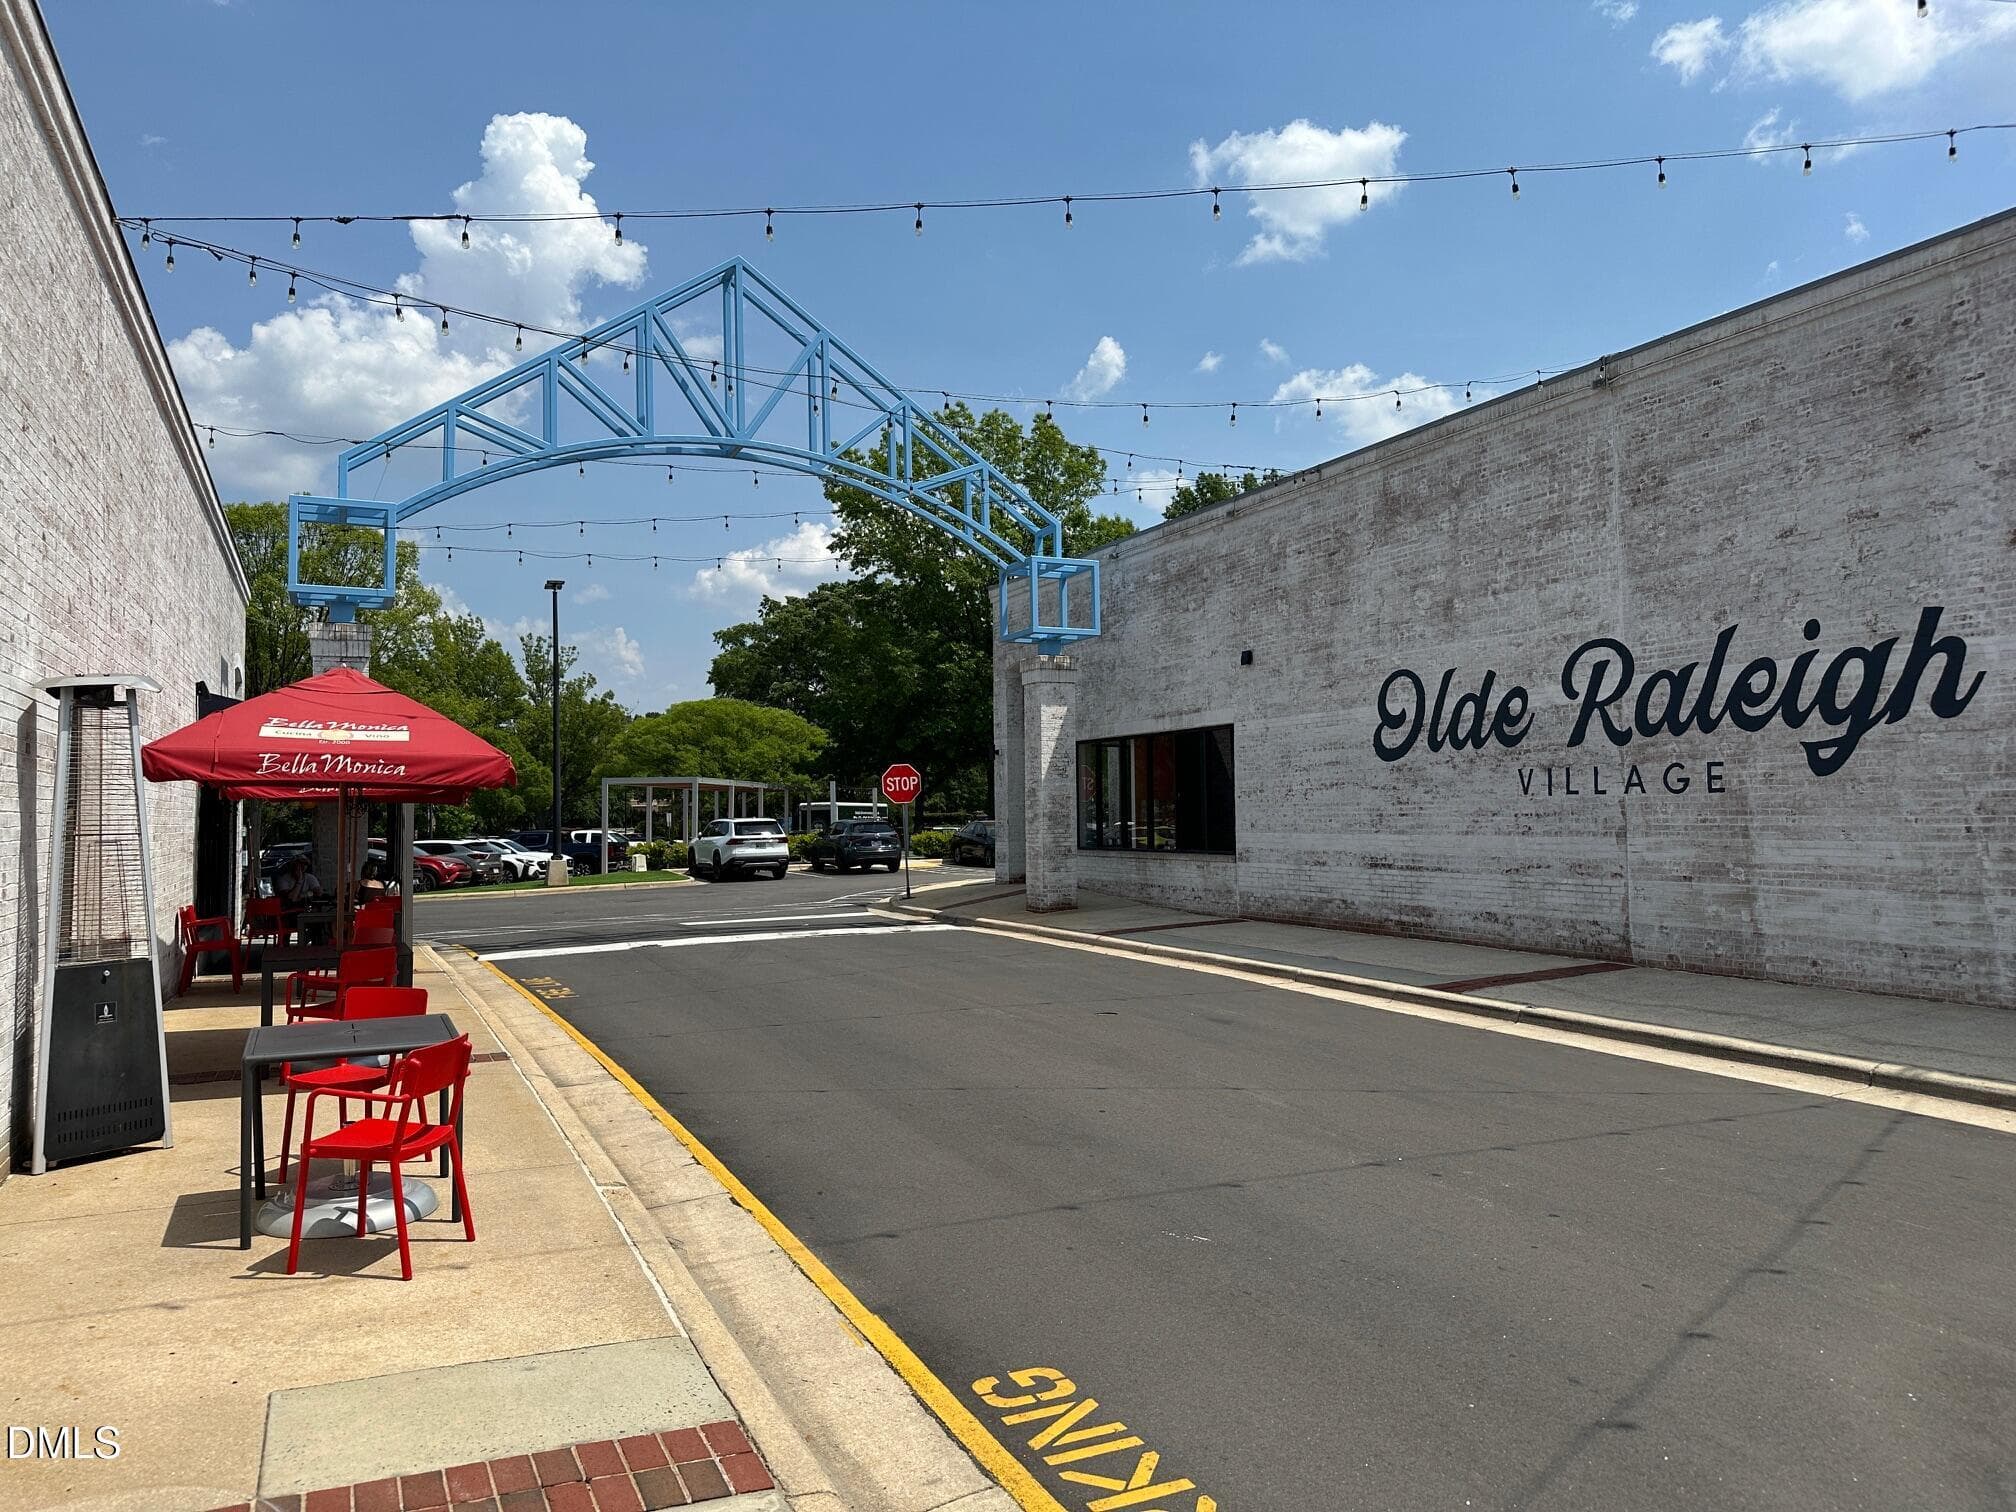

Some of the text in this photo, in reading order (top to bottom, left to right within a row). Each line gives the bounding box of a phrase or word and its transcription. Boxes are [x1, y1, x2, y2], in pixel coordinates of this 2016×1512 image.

[1373, 606, 1987, 777] Olde Raleigh
[263, 717, 409, 731] Bella Monica
[256, 753, 406, 776] Bella Monica
[1518, 761, 1726, 795] VILLAGE
[886, 776, 918, 792] STOP
[971, 1367, 1218, 1512] KING
